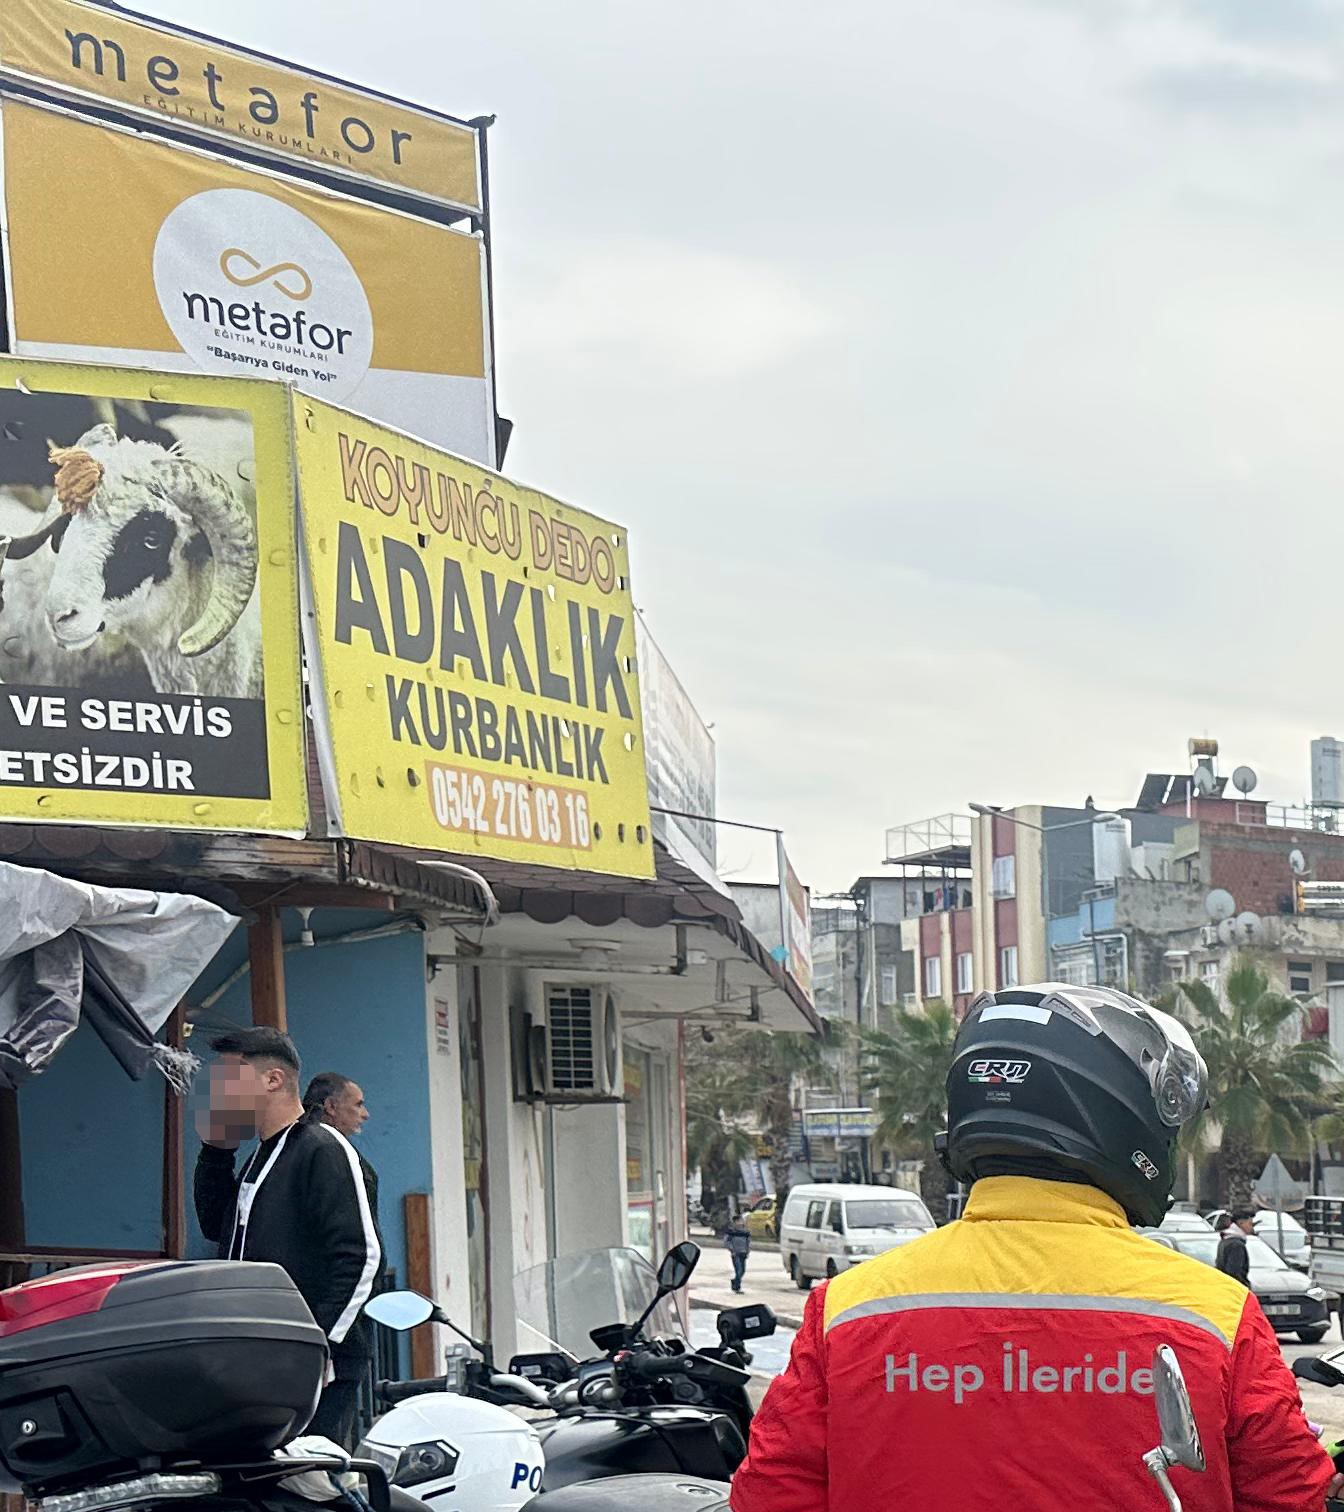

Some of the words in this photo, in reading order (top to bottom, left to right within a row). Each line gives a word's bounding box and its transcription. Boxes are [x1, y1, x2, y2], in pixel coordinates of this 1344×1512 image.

[64, 28, 412, 166] metafor
[238, 122, 353, 164] KURUMLARI
[183, 291, 352, 354] metafor
[260, 340, 329, 362] KURUMLARI
[272, 360, 309, 377] Giden
[338, 432, 522, 560] KOYUNCU
[529, 509, 615, 595] DEDO
[334, 522, 634, 719] ADAKLIK
[9, 695, 67, 728] VE
[80, 698, 232, 738] SERVİS
[385, 674, 610, 784] KURBANLIK
[0, 747, 195, 790] ETSİZDİR
[431, 767, 490, 833] 0542
[492, 778, 532, 839] 276
[534, 786, 562, 844] 03
[565, 793, 590, 847] 16
[885, 1352, 985, 1405] Hep
[1002, 1341, 1155, 1395] İleride
[510, 1462, 543, 1493] PO
